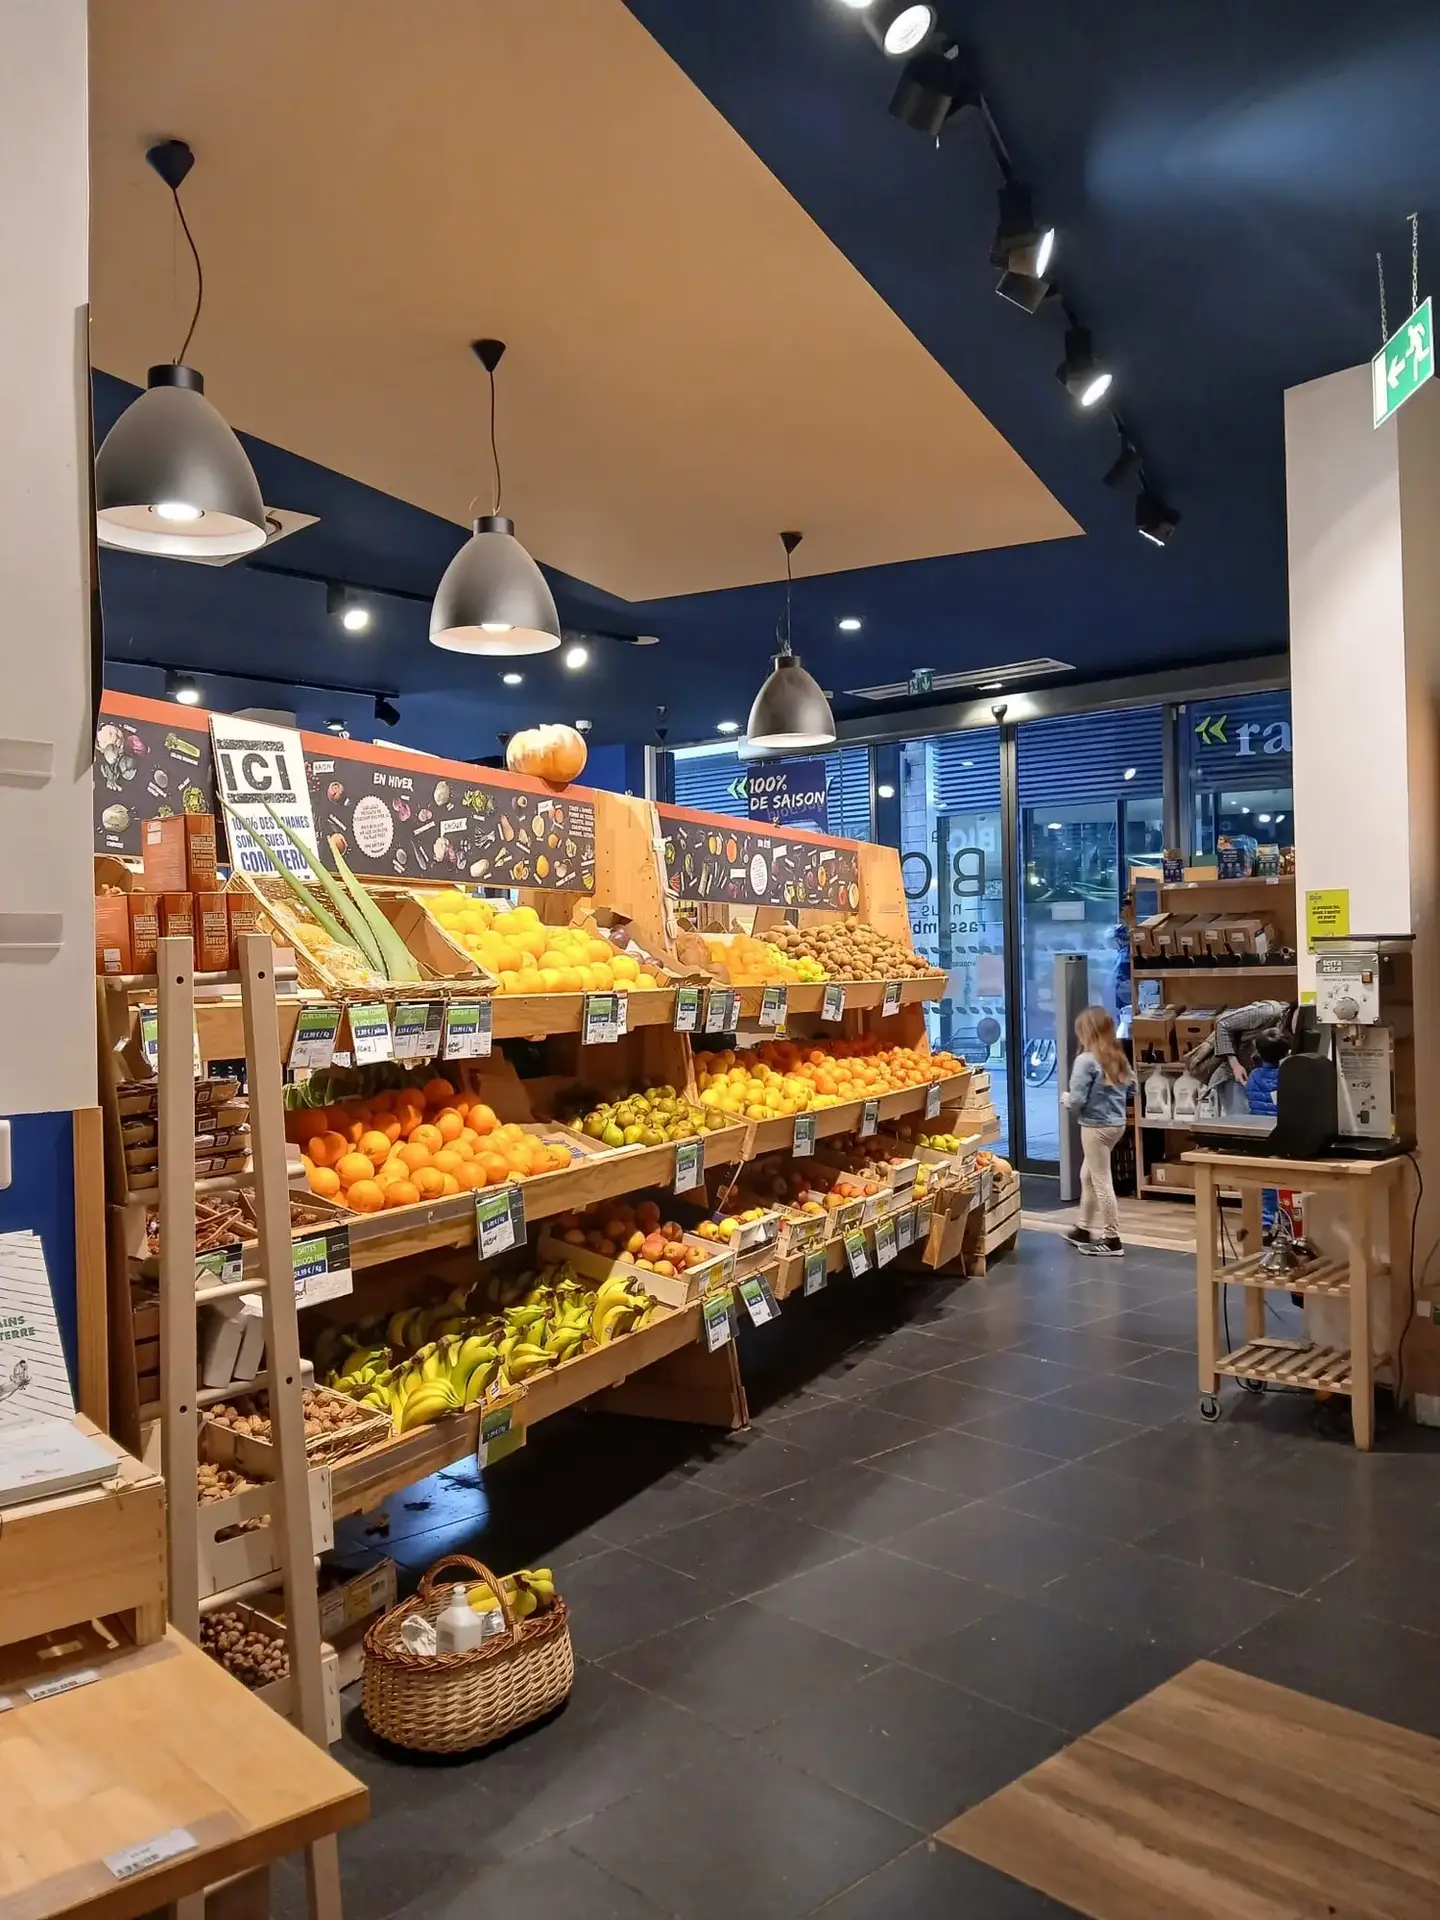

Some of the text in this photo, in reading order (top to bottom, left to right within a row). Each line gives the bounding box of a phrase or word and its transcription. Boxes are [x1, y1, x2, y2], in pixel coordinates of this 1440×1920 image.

[1235, 721, 1292, 756] ra
[220, 752, 292, 791] ICI
[373, 773, 414, 791] EN HIVER
[749, 774, 788, 794] 100%
[750, 790, 826, 811] DE SAISON
[259, 816, 275, 830] DES
[277, 815, 310, 829] NANES
[259, 833, 285, 847] SUES
[240, 848, 308, 873] COMERC
[1322, 959, 1342, 967] terra
[0, 1326, 36, 1341] TERRE
